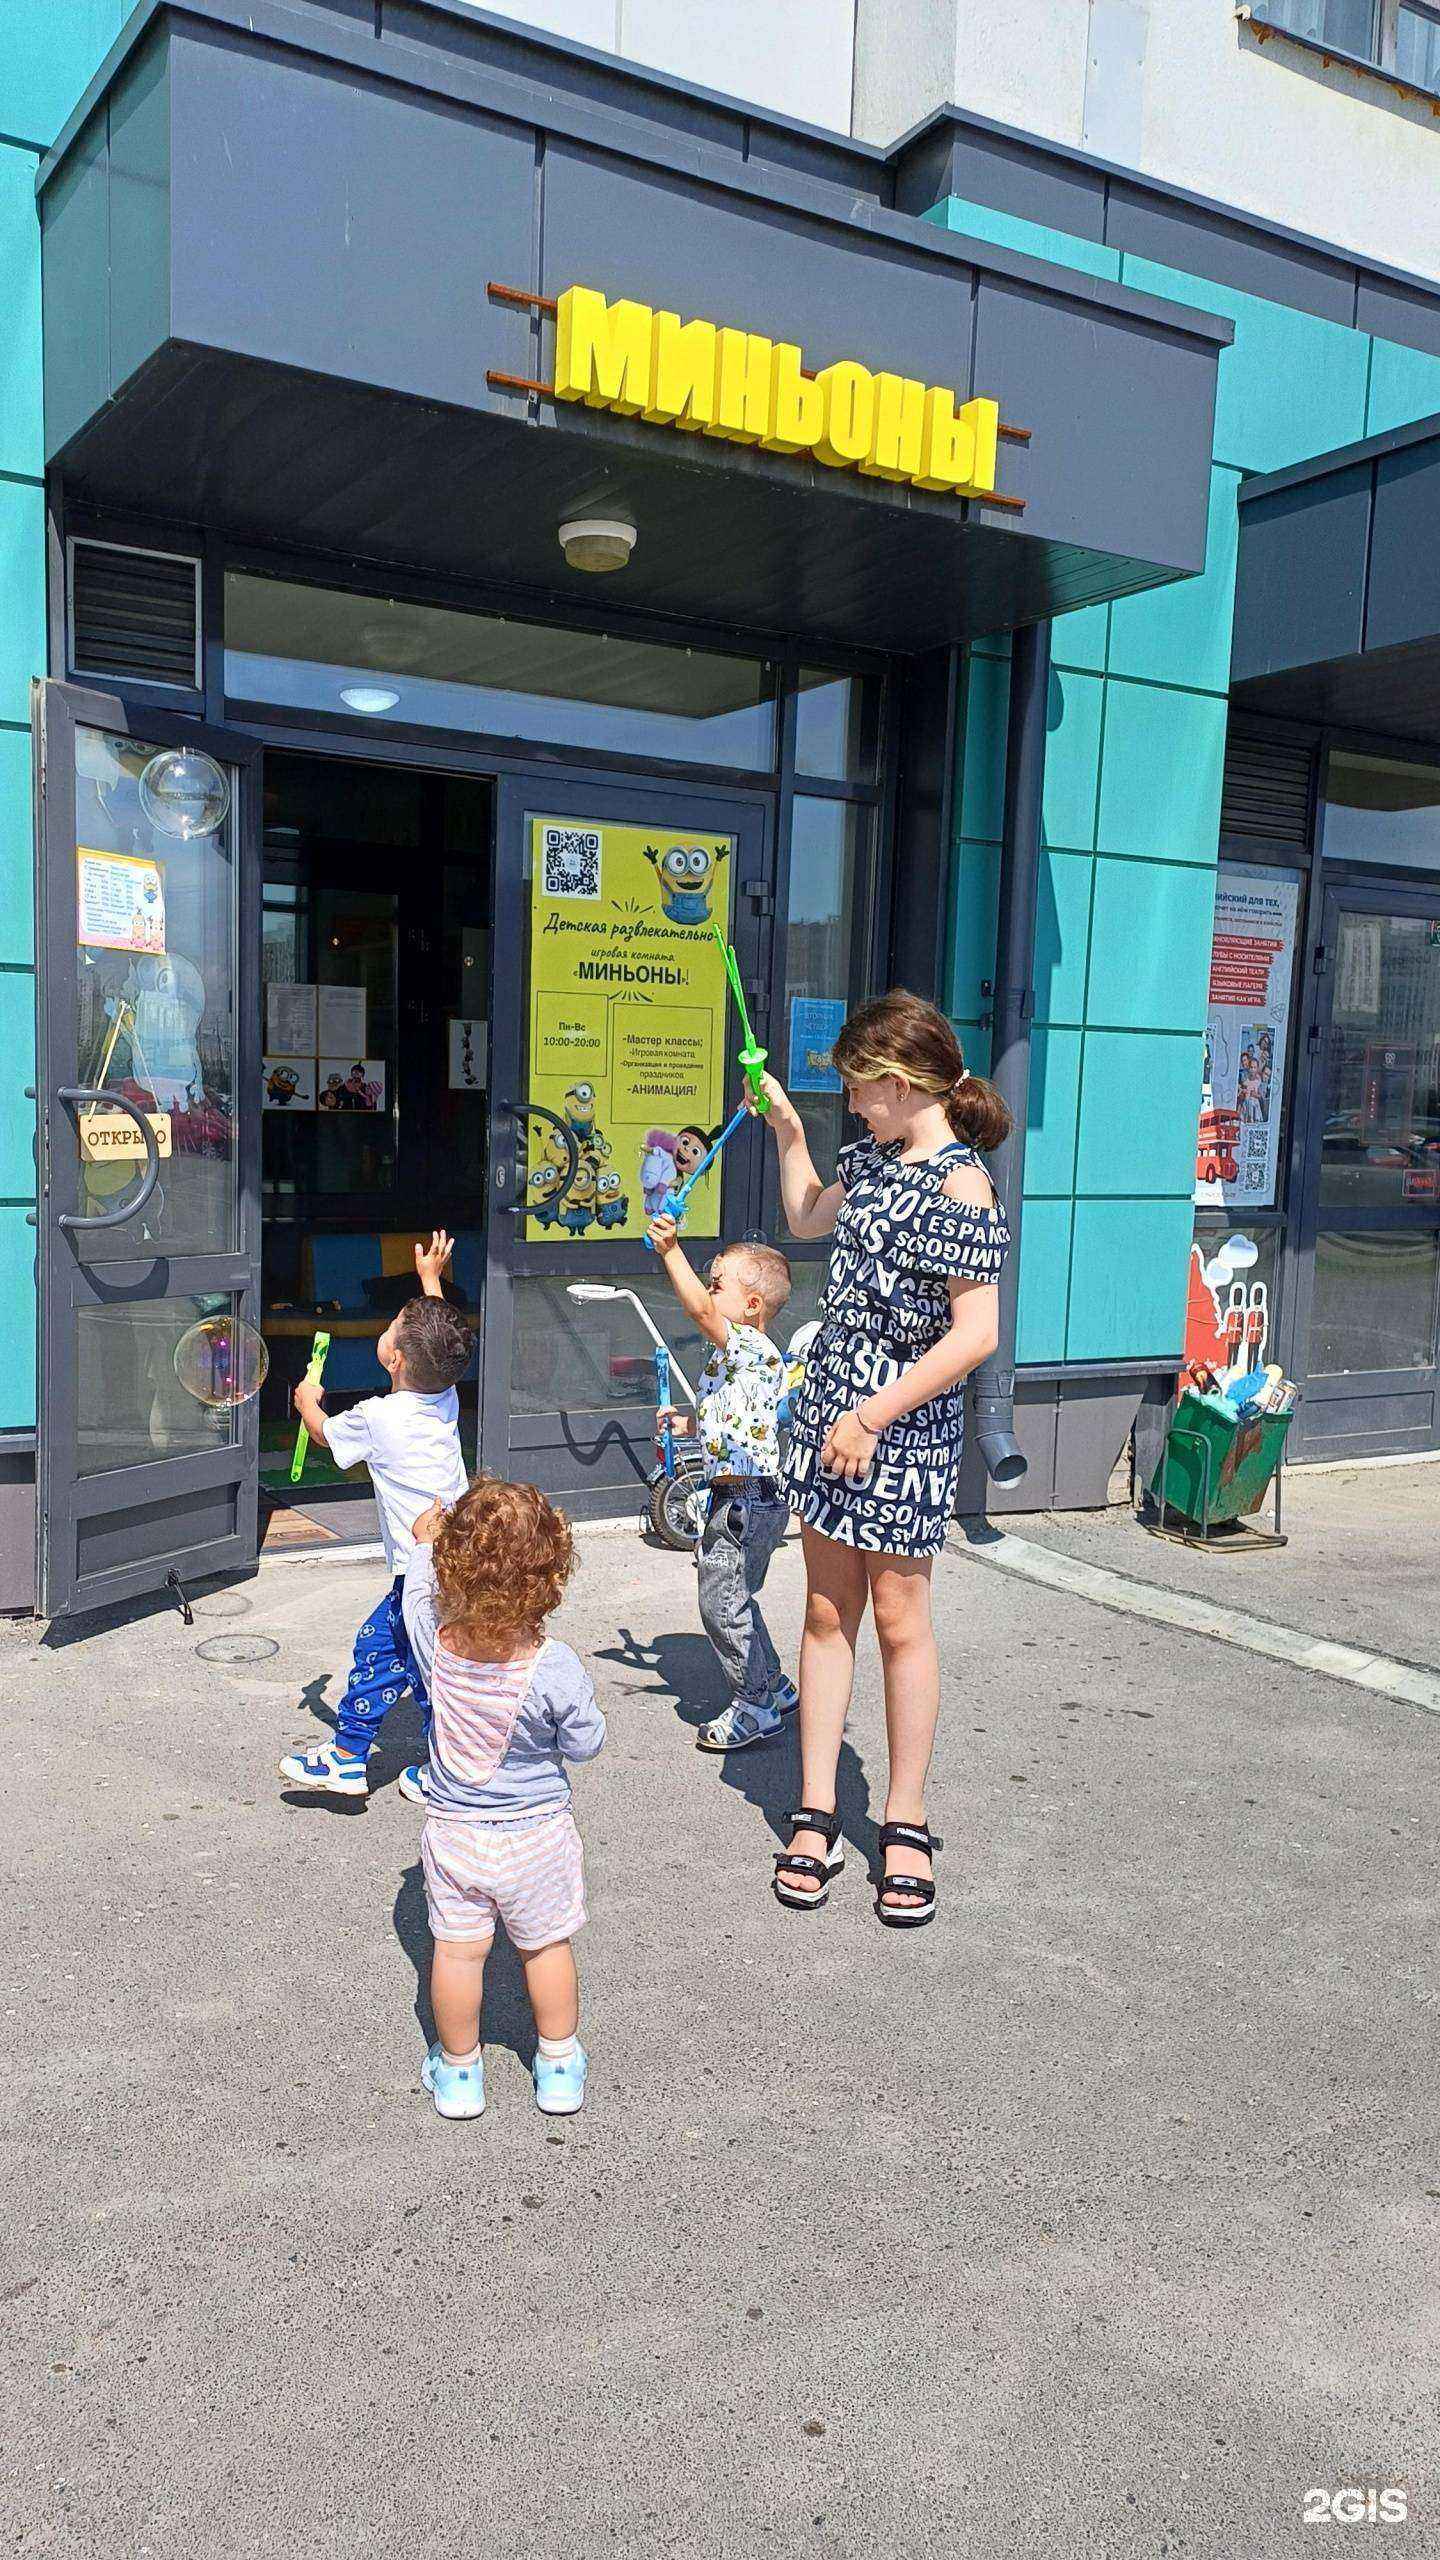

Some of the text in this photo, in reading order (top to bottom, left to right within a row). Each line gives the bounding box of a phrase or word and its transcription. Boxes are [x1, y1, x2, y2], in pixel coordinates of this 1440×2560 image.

[555, 285, 998, 497] МИНЬОНЫ
[1248, 896, 1263, 906] ДЛЯ
[543, 912, 607, 934] Детская
[590, 946, 675, 962] игровая комната
[558, 1021, 586, 1032] Пн-Вс
[543, 1036, 600, 1048] 10:00-20:00
[88, 1130, 166, 1146] ОТКРЫО
